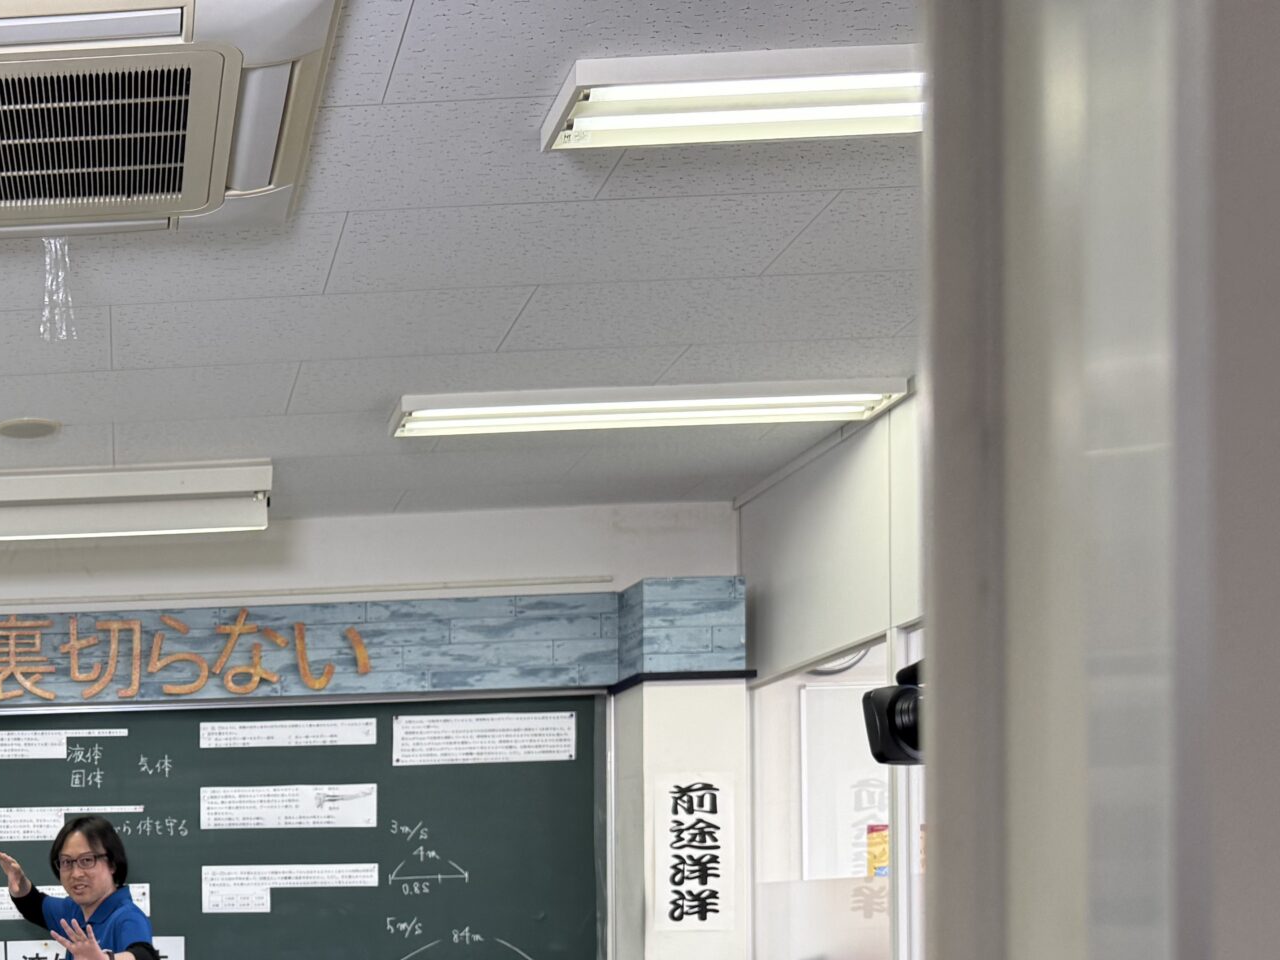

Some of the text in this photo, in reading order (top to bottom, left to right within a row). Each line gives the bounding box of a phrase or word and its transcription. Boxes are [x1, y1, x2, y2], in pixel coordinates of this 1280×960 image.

[67, 743, 103, 765] 液体
[138, 754, 172, 777] 気体
[71, 768, 104, 788] 固体
[412, 846, 440, 861] 4m
[669, 782, 720, 921] 前途洋洋
